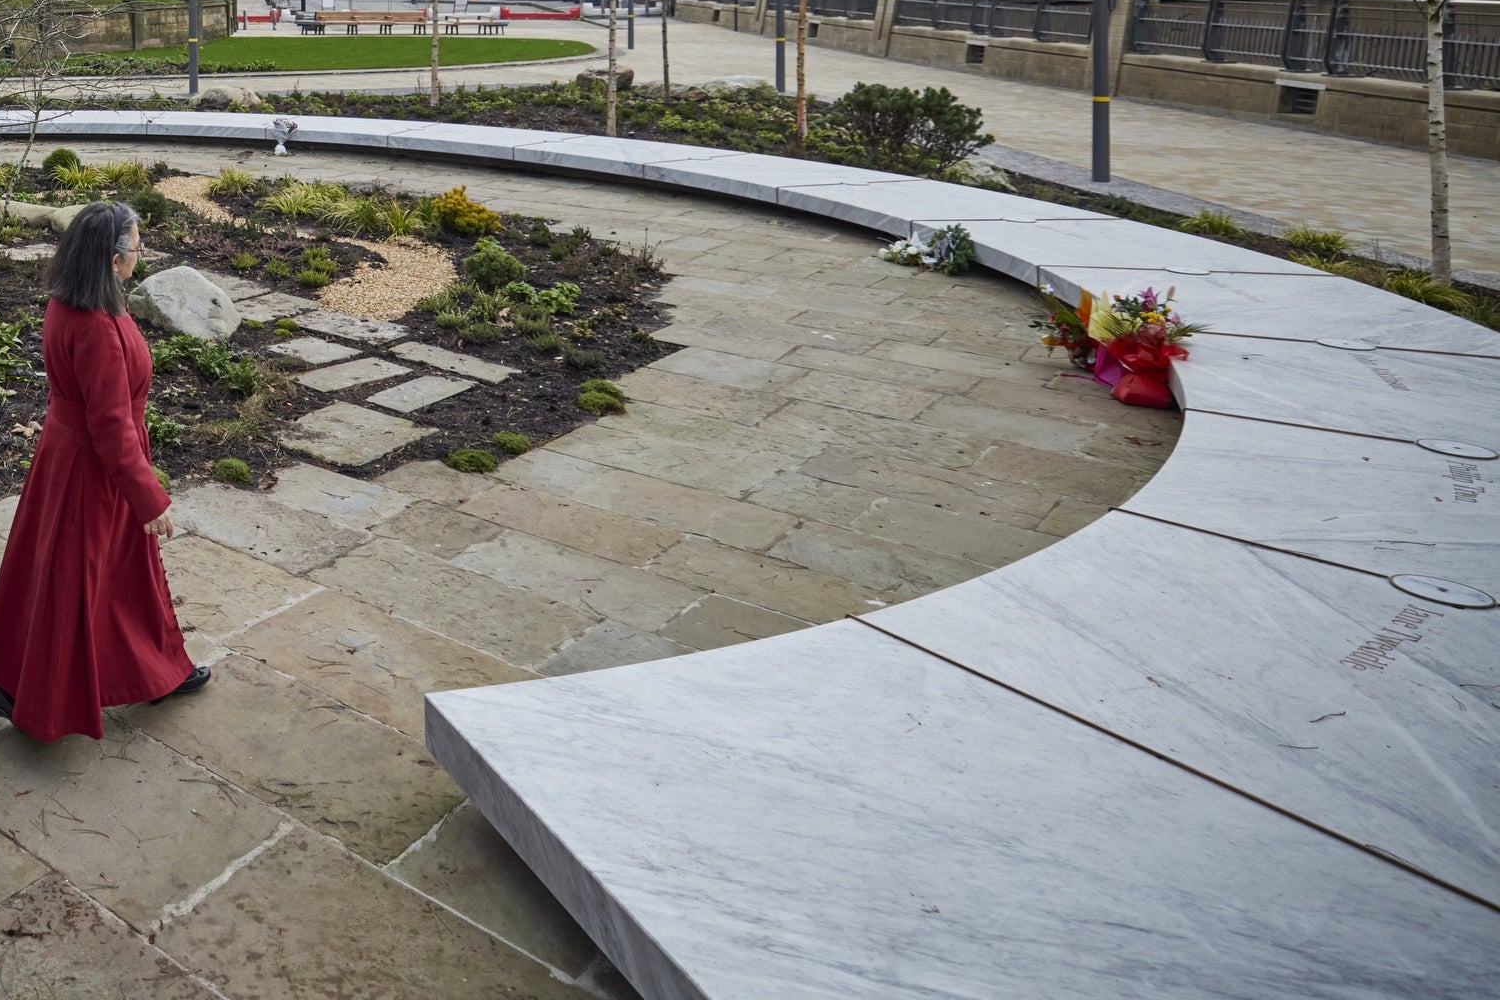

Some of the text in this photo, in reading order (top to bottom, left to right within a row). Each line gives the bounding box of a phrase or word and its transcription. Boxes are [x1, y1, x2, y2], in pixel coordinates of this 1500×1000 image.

[1443, 460, 1482, 484] Philip
[1339, 603, 1445, 671] Jane Tweddle
